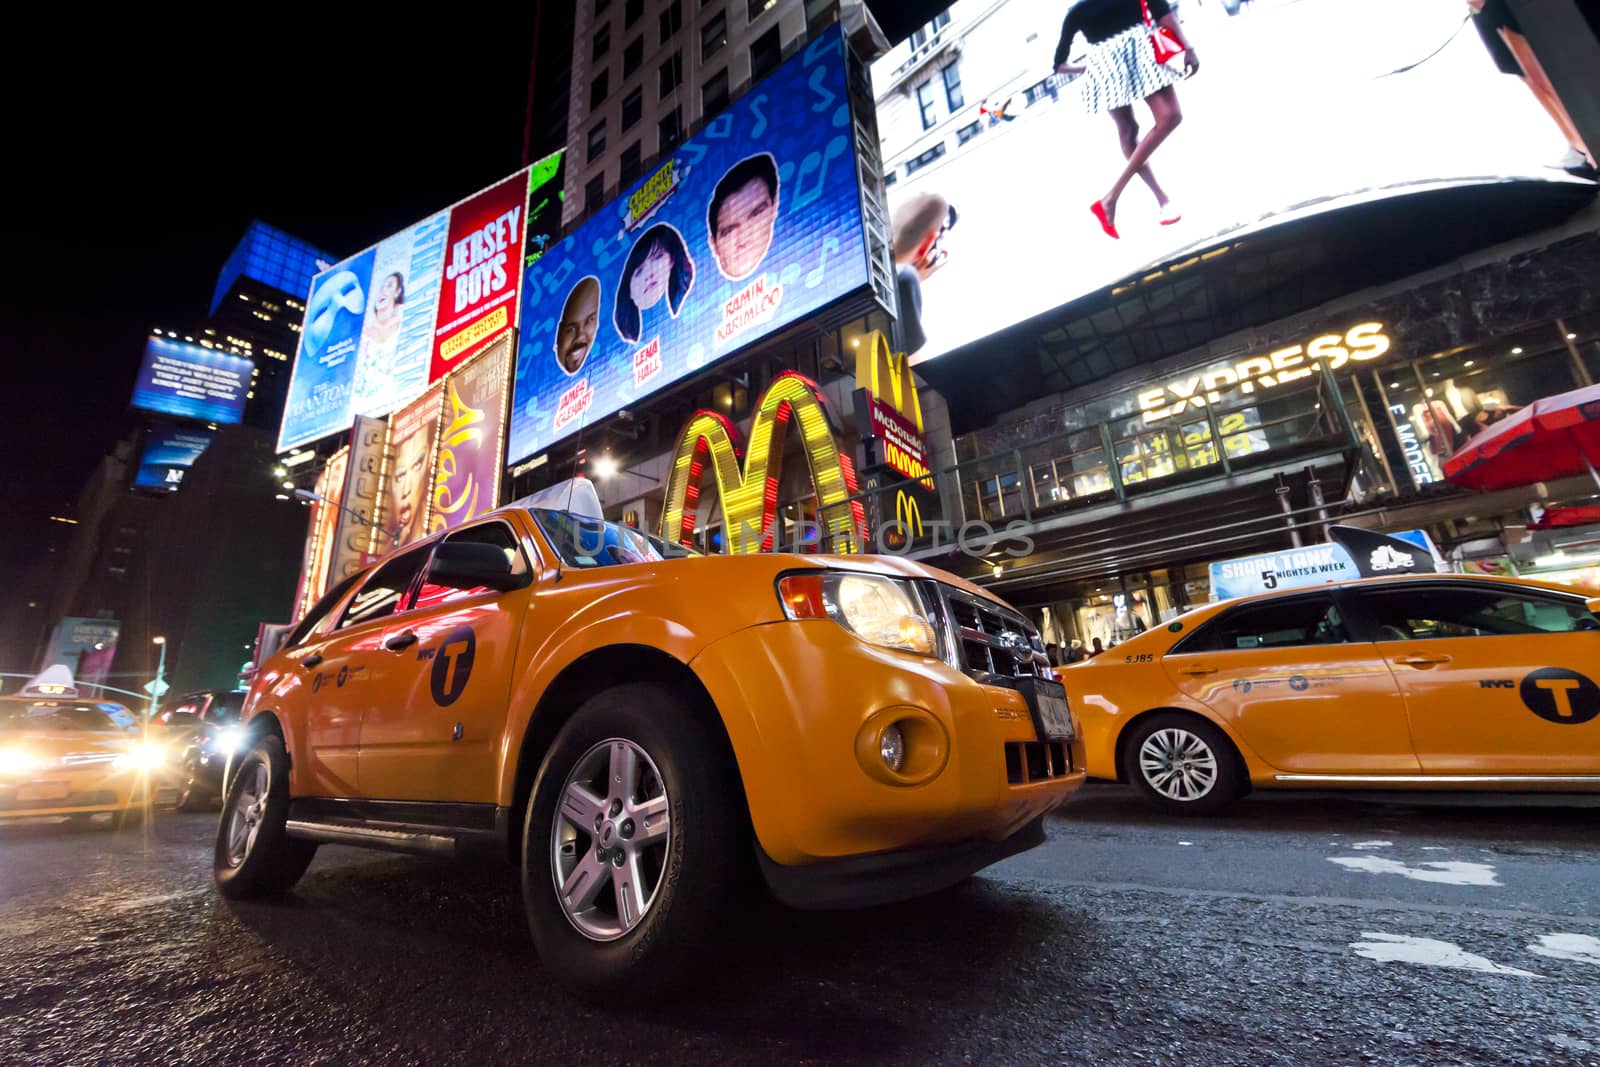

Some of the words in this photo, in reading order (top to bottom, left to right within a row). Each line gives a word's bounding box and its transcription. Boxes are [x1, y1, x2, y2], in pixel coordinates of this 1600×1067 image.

[446, 205, 521, 280] JERSEY
[454, 252, 507, 313] BOYS
[725, 279, 764, 314] RAMIN
[634, 340, 658, 366] LENA
[636, 359, 660, 384] HALL
[1138, 322, 1391, 425] EXPRESS
[1222, 554, 1278, 579] SHARK
[1279, 547, 1336, 568] TANK
[1261, 570, 1277, 589] 5
[1276, 567, 1310, 579] NIGHTS
[1311, 565, 1318, 574] A
[1320, 561, 1346, 574] WEEK
[1479, 680, 1515, 689] NYC
[1535, 678, 1580, 717] T
